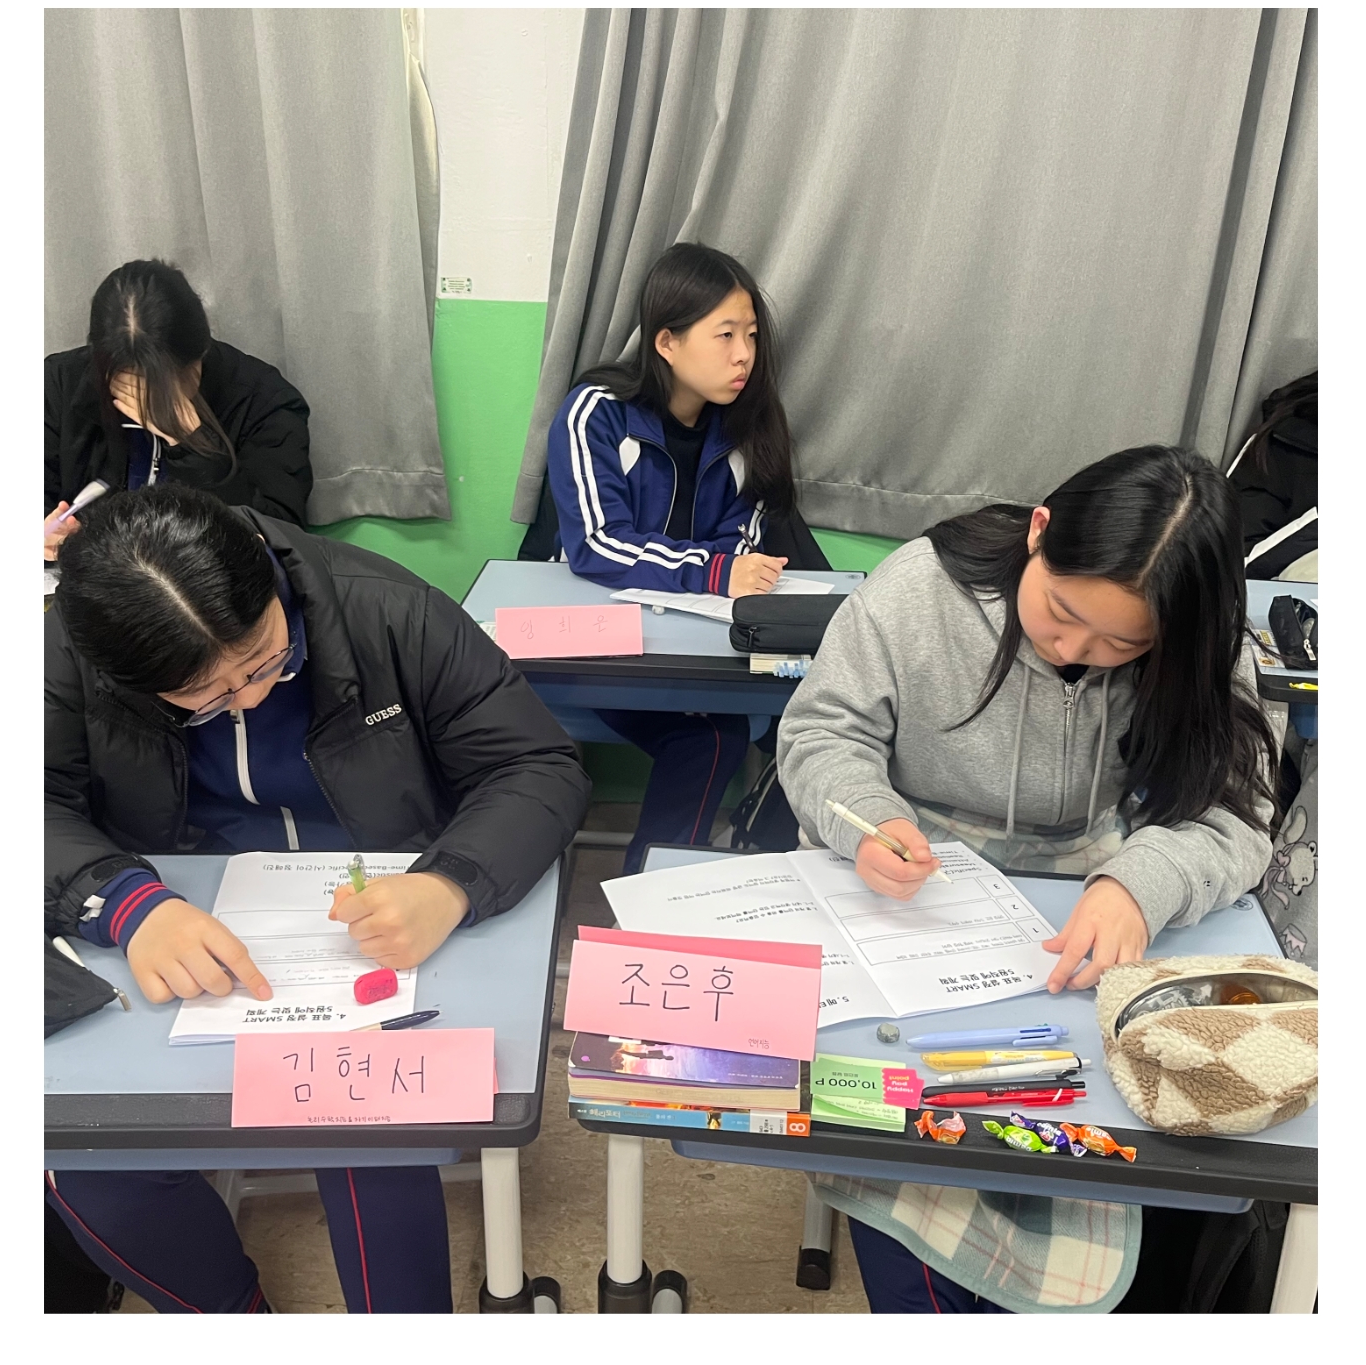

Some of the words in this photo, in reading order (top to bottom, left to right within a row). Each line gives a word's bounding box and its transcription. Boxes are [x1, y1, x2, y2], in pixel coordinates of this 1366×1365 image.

[365, 703, 403, 726] GUESS
[619, 963, 735, 1022] 조은후
[295, 1006, 333, 1014] 5원칙에
[283, 1046, 425, 1102] 김현서
[815, 1078, 826, 1088] P
[827, 1077, 878, 1091] 10,000
